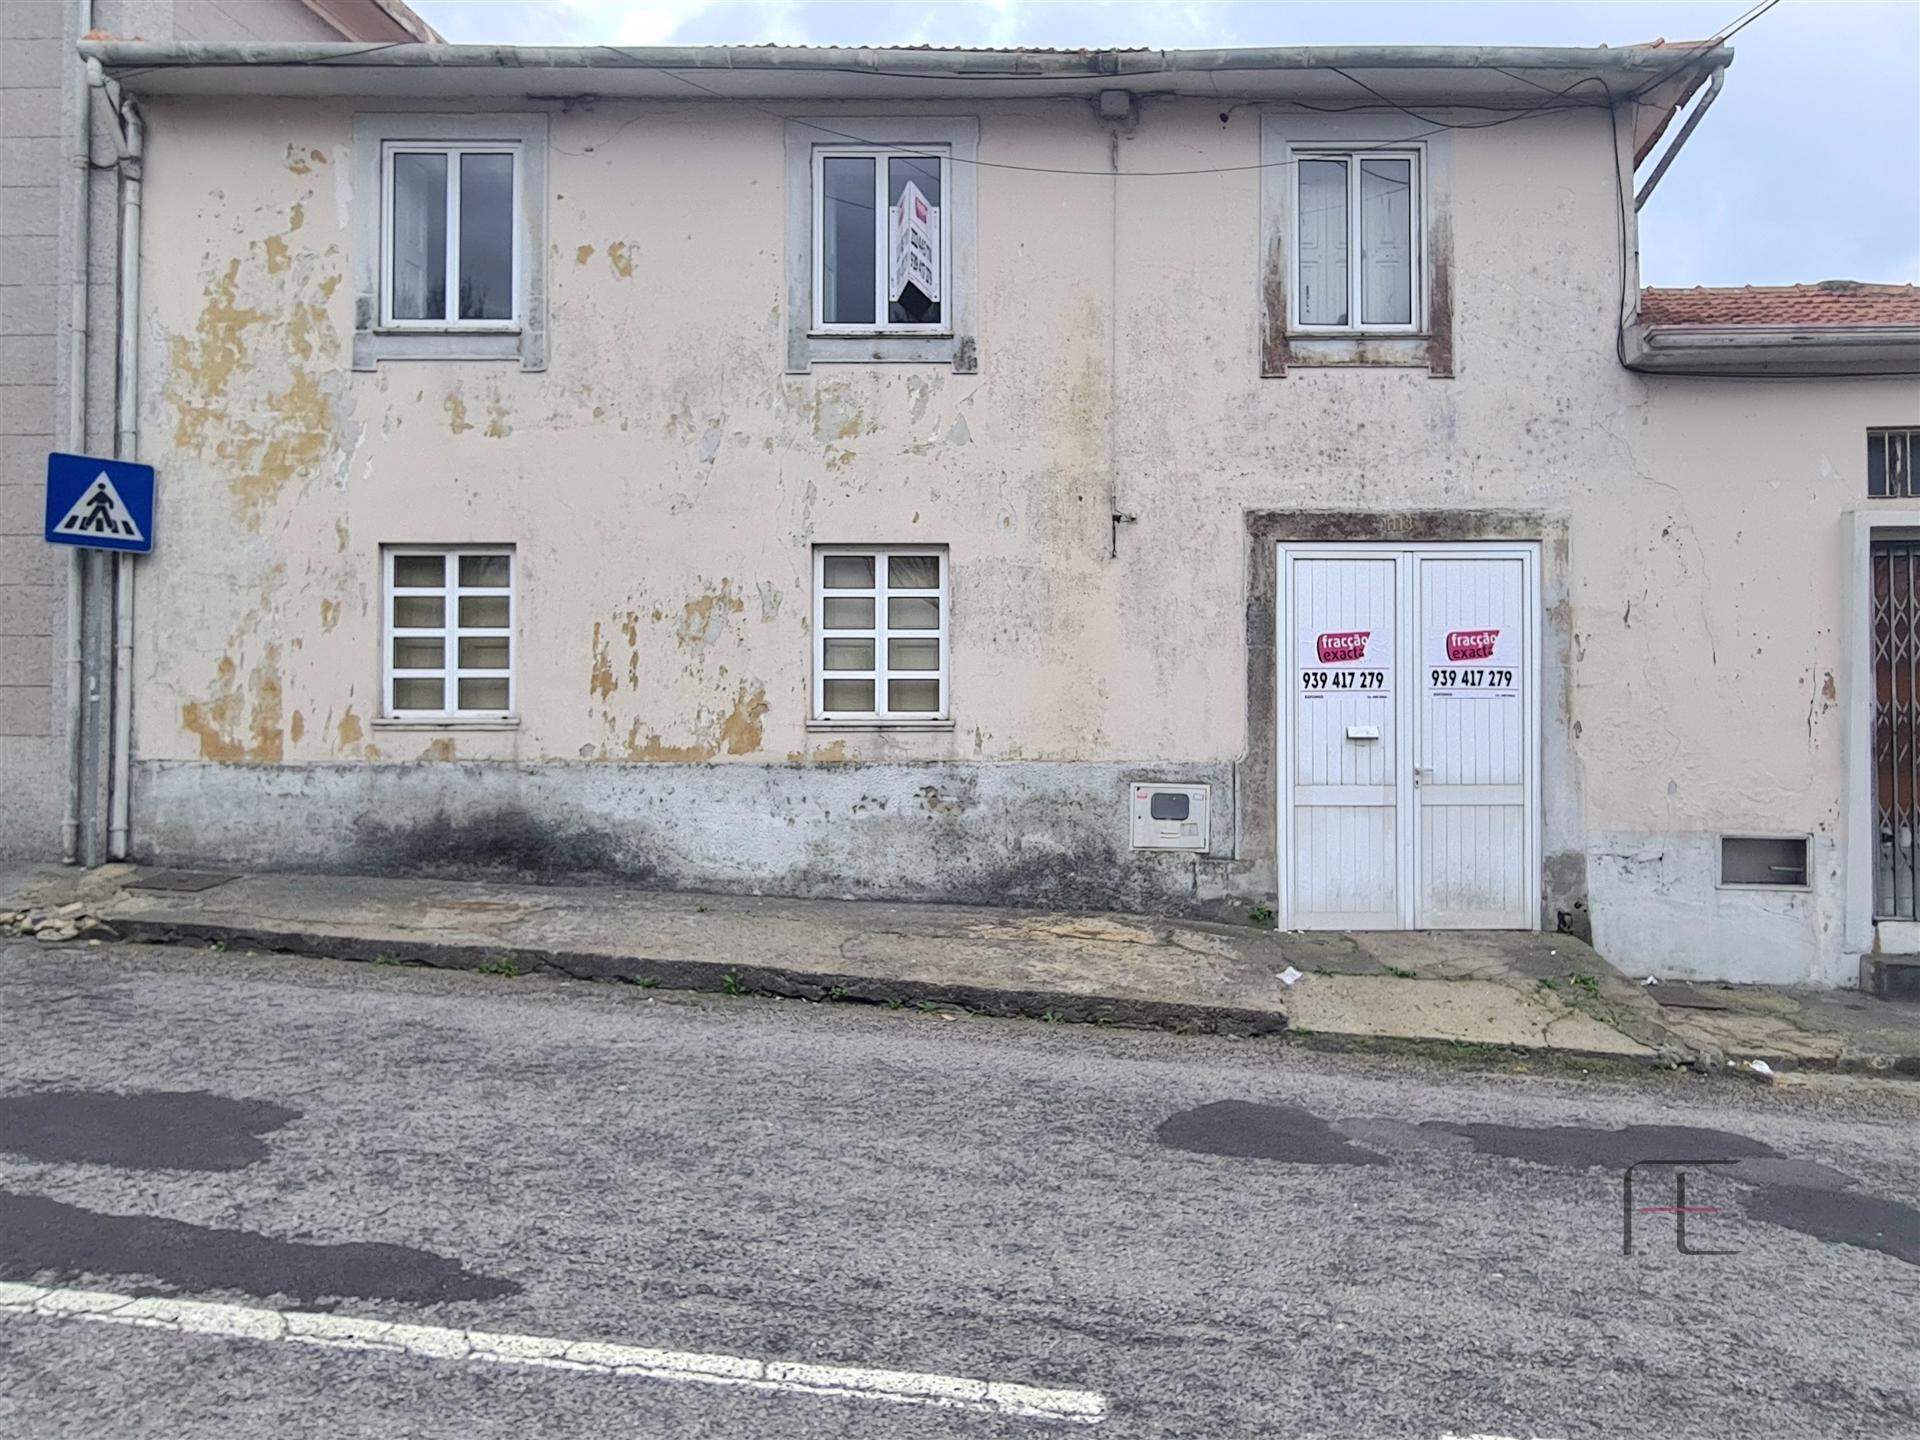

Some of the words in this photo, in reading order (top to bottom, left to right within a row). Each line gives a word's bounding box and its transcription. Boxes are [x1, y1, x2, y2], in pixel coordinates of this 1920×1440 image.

[1322, 634, 1367, 649] fracção
[1451, 632, 1497, 648] fracção
[1303, 672, 1328, 689] 939
[1332, 672, 1355, 688] 417
[1360, 672, 1384, 688] 279
[1431, 670, 1457, 687] 939
[1461, 670, 1484, 686] 417
[1488, 670, 1512, 687] 279
